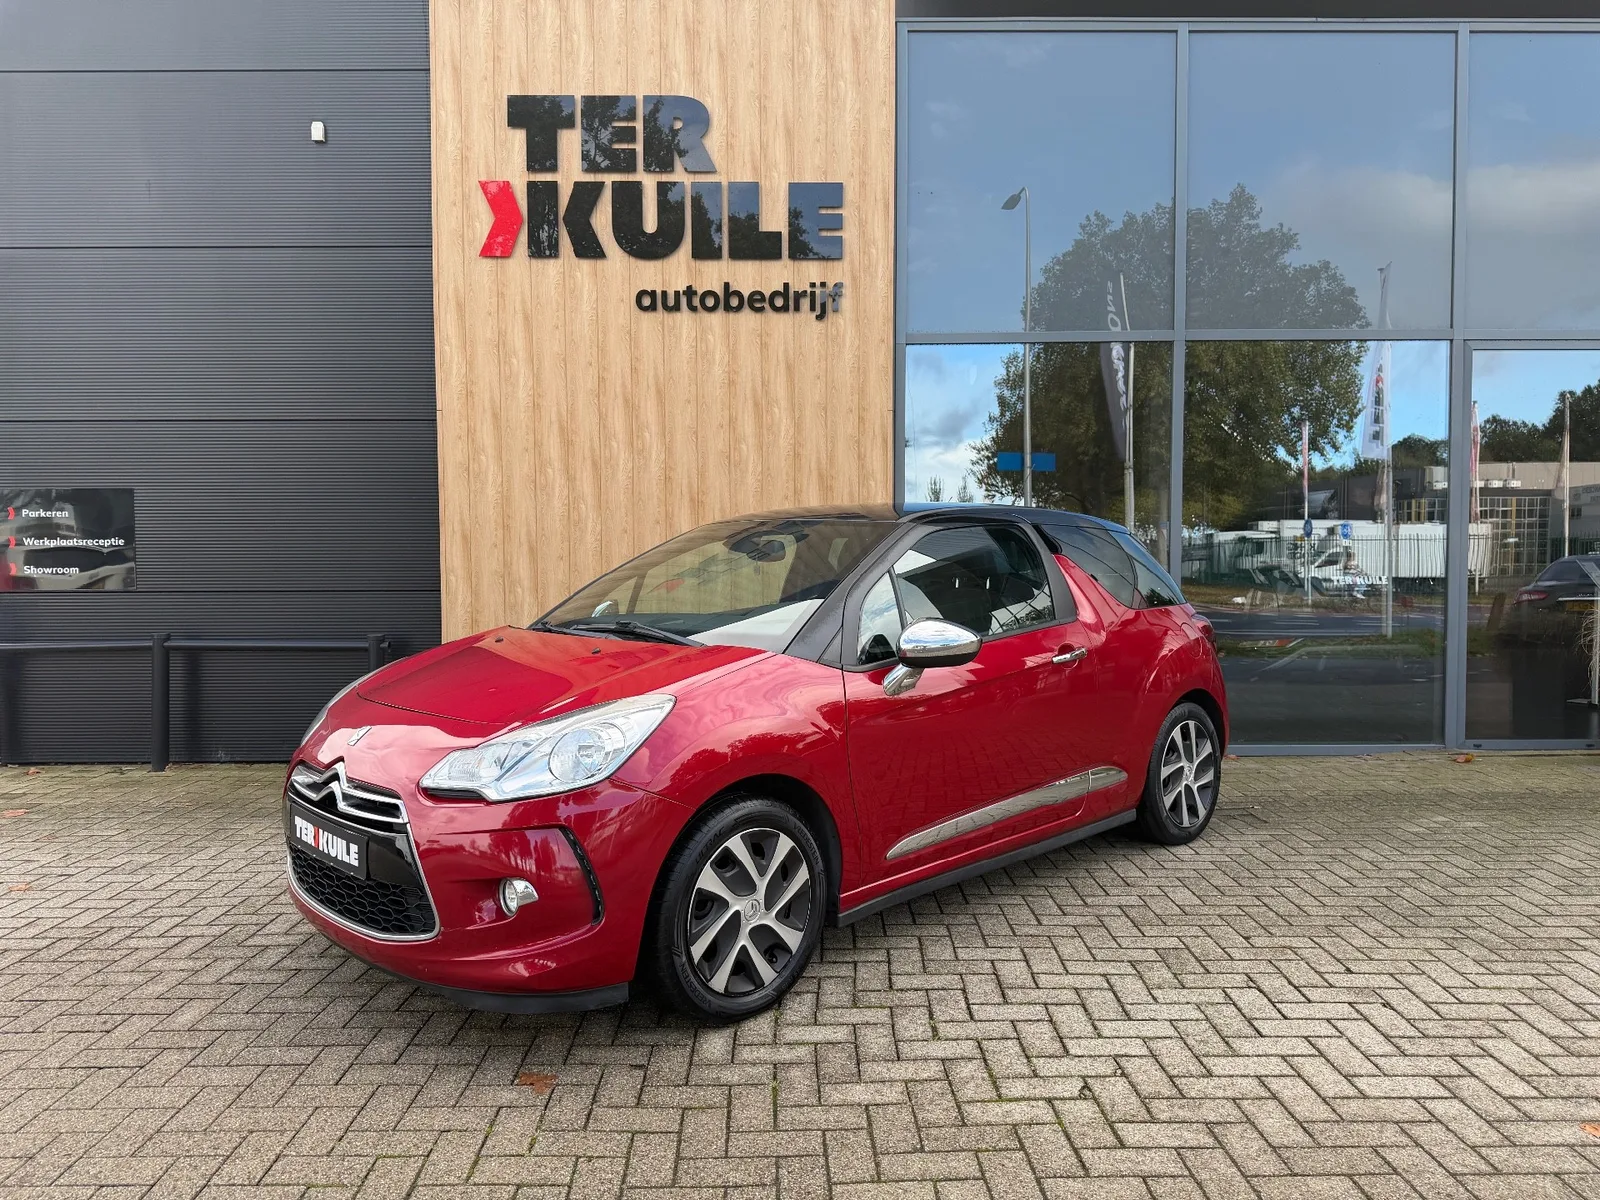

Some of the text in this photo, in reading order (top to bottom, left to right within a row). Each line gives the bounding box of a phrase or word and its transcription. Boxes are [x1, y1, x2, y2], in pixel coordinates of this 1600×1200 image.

[507, 95, 717, 172] TER
[527, 181, 844, 260] KUILE
[635, 281, 844, 320] autobedrijf
[22, 508, 69, 518] Parkeren
[23, 537, 125, 548] Werkplaatsreceptie
[24, 565, 79, 574] Showroom
[294, 815, 359, 867] TER KUILE
